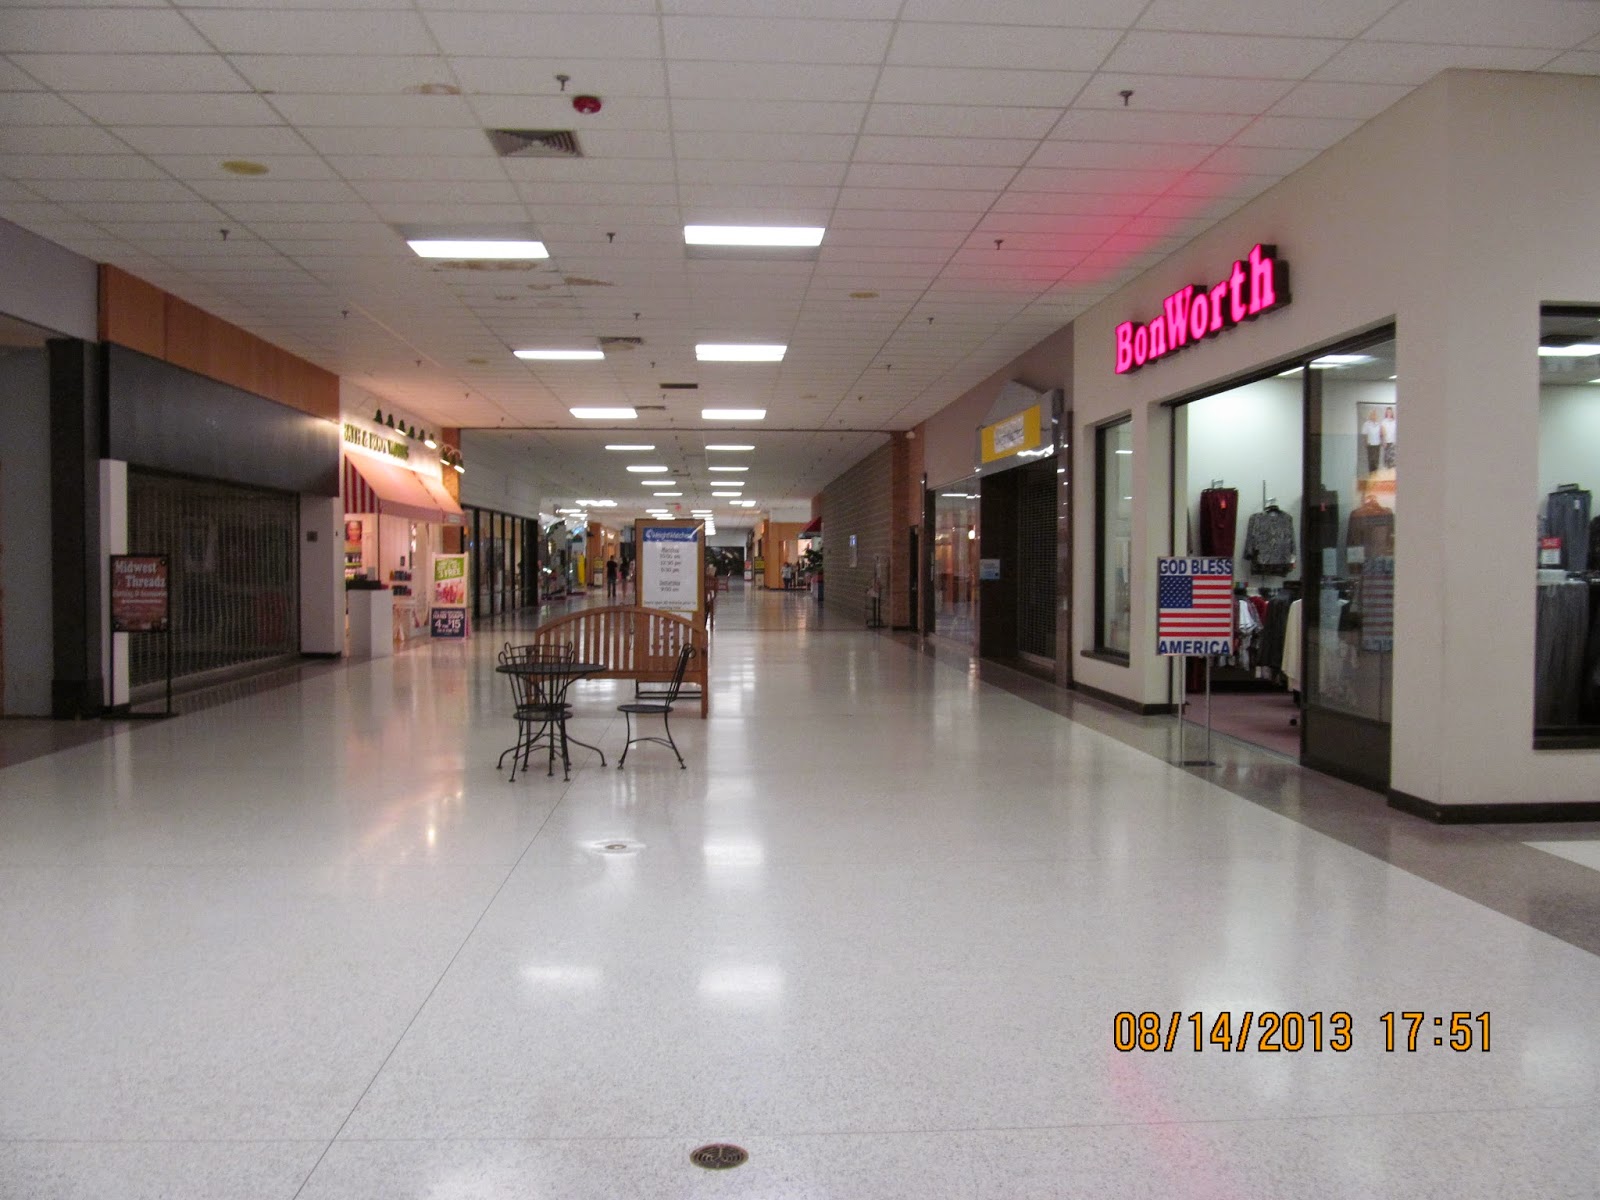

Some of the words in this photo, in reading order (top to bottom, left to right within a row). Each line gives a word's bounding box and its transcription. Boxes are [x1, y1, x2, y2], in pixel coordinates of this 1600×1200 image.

[1115, 243, 1276, 375] BonWorth
[115, 560, 156, 573] Midwest
[1160, 559, 1187, 575] GOD
[1191, 559, 1232, 575] BLESS
[125, 575, 166, 588] Threadz
[435, 619, 442, 628] 4
[1159, 640, 1230, 655] AMERICA
